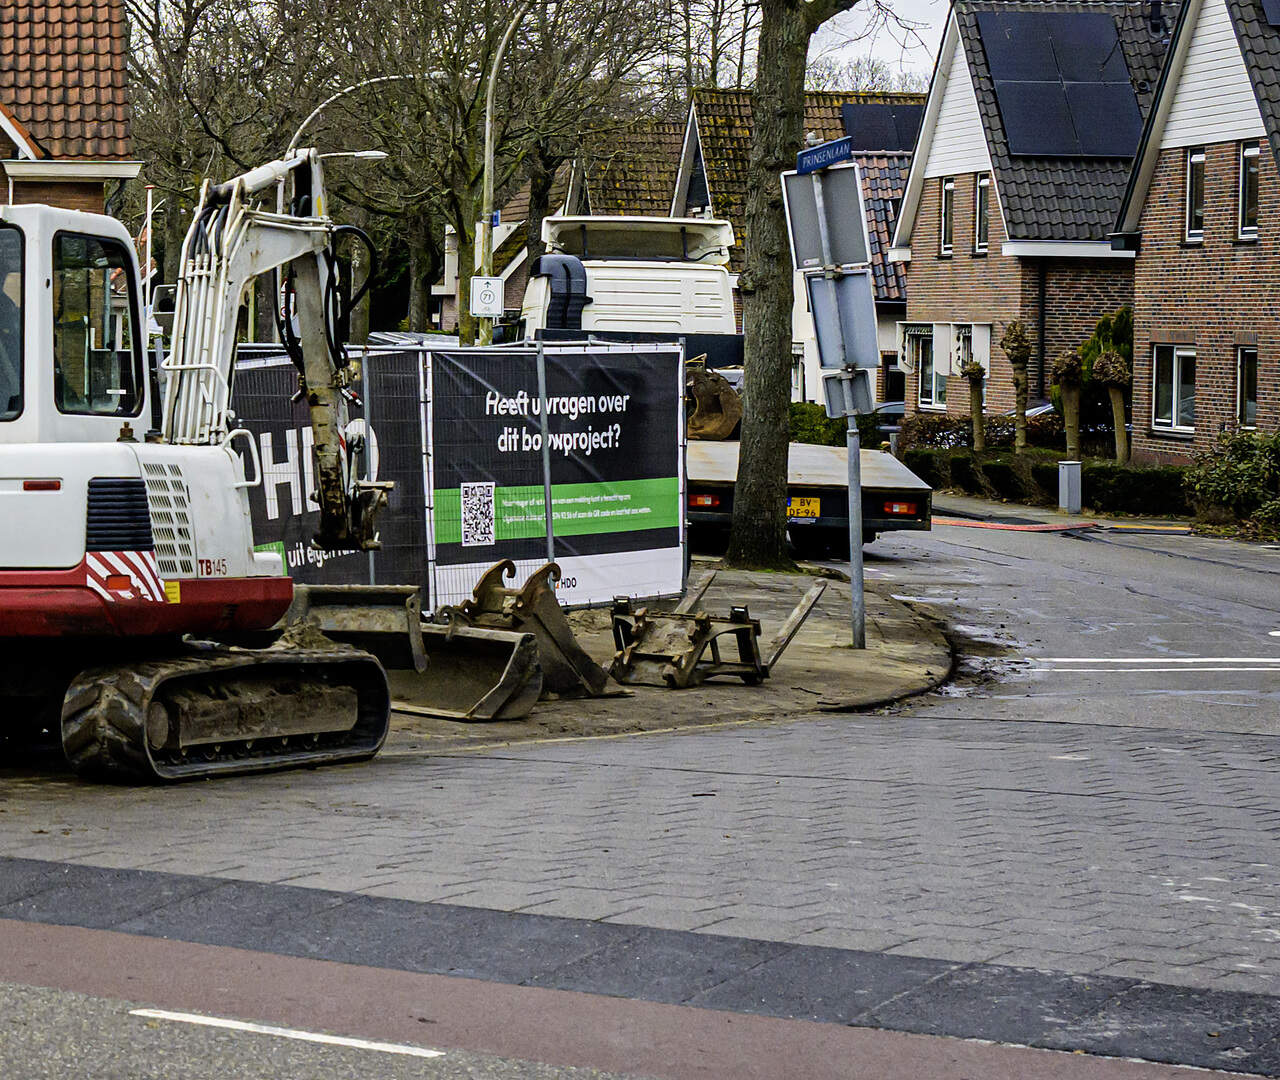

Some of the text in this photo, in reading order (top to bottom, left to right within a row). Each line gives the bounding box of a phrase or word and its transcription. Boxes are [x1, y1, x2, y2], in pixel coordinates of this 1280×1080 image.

[802, 143, 850, 168] PRINSENLAAN
[485, 390, 630, 420] Heeft u vragen over
[497, 423, 621, 456] dit bowproject?
[789, 508, 816, 517] DF-96
[800, 498, 811, 506] BV
[287, 541, 305, 568] uit
[198, 558, 227, 576] TB145
[560, 577, 577, 588] HDO
